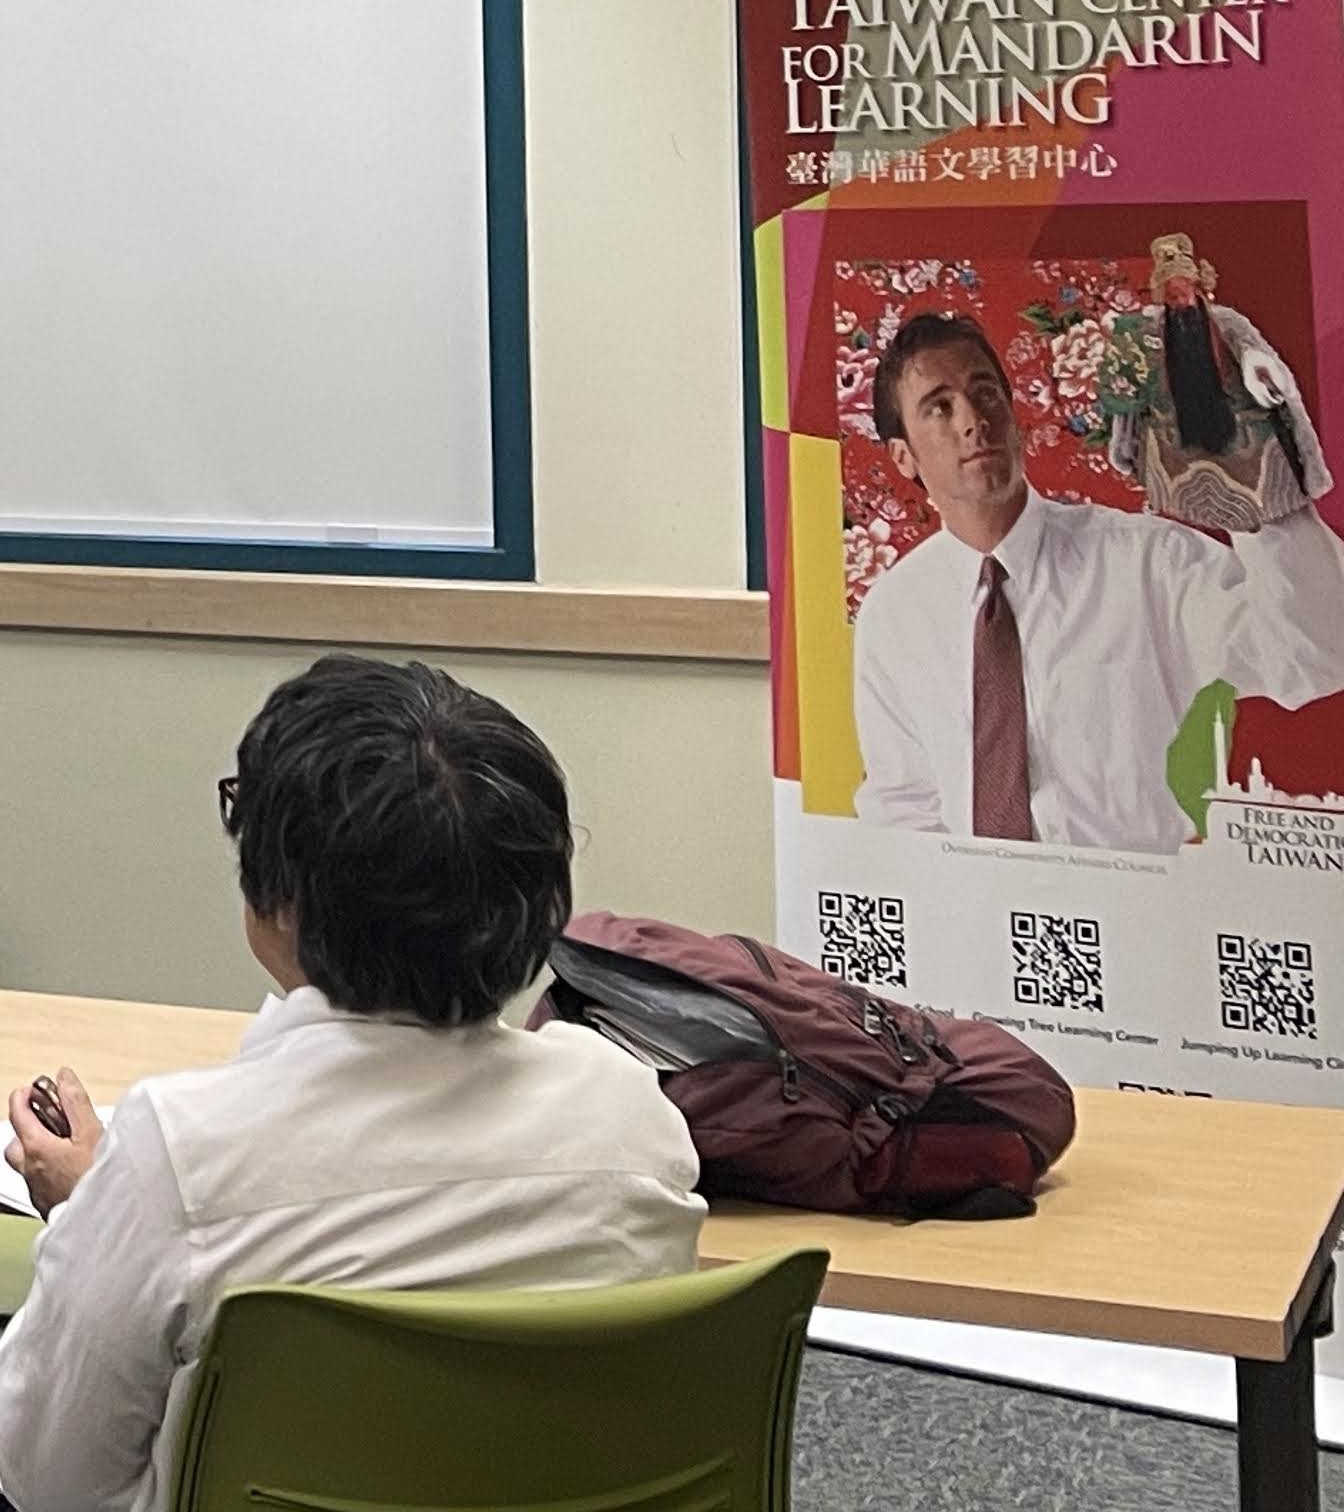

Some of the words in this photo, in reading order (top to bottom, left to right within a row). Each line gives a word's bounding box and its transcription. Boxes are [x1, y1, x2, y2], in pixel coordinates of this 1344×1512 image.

[781, 44, 870, 83] FOR
[883, 9, 1263, 78] MANDARIN
[784, 72, 1113, 135] LEARNING
[785, 143, 1118, 185] 臺灣華語文學習中心
[1243, 807, 1286, 827] FREE
[1291, 814, 1335, 831] AND
[1241, 840, 1344, 872] TAIWAN
[1242, 1046, 1262, 1061] Up
